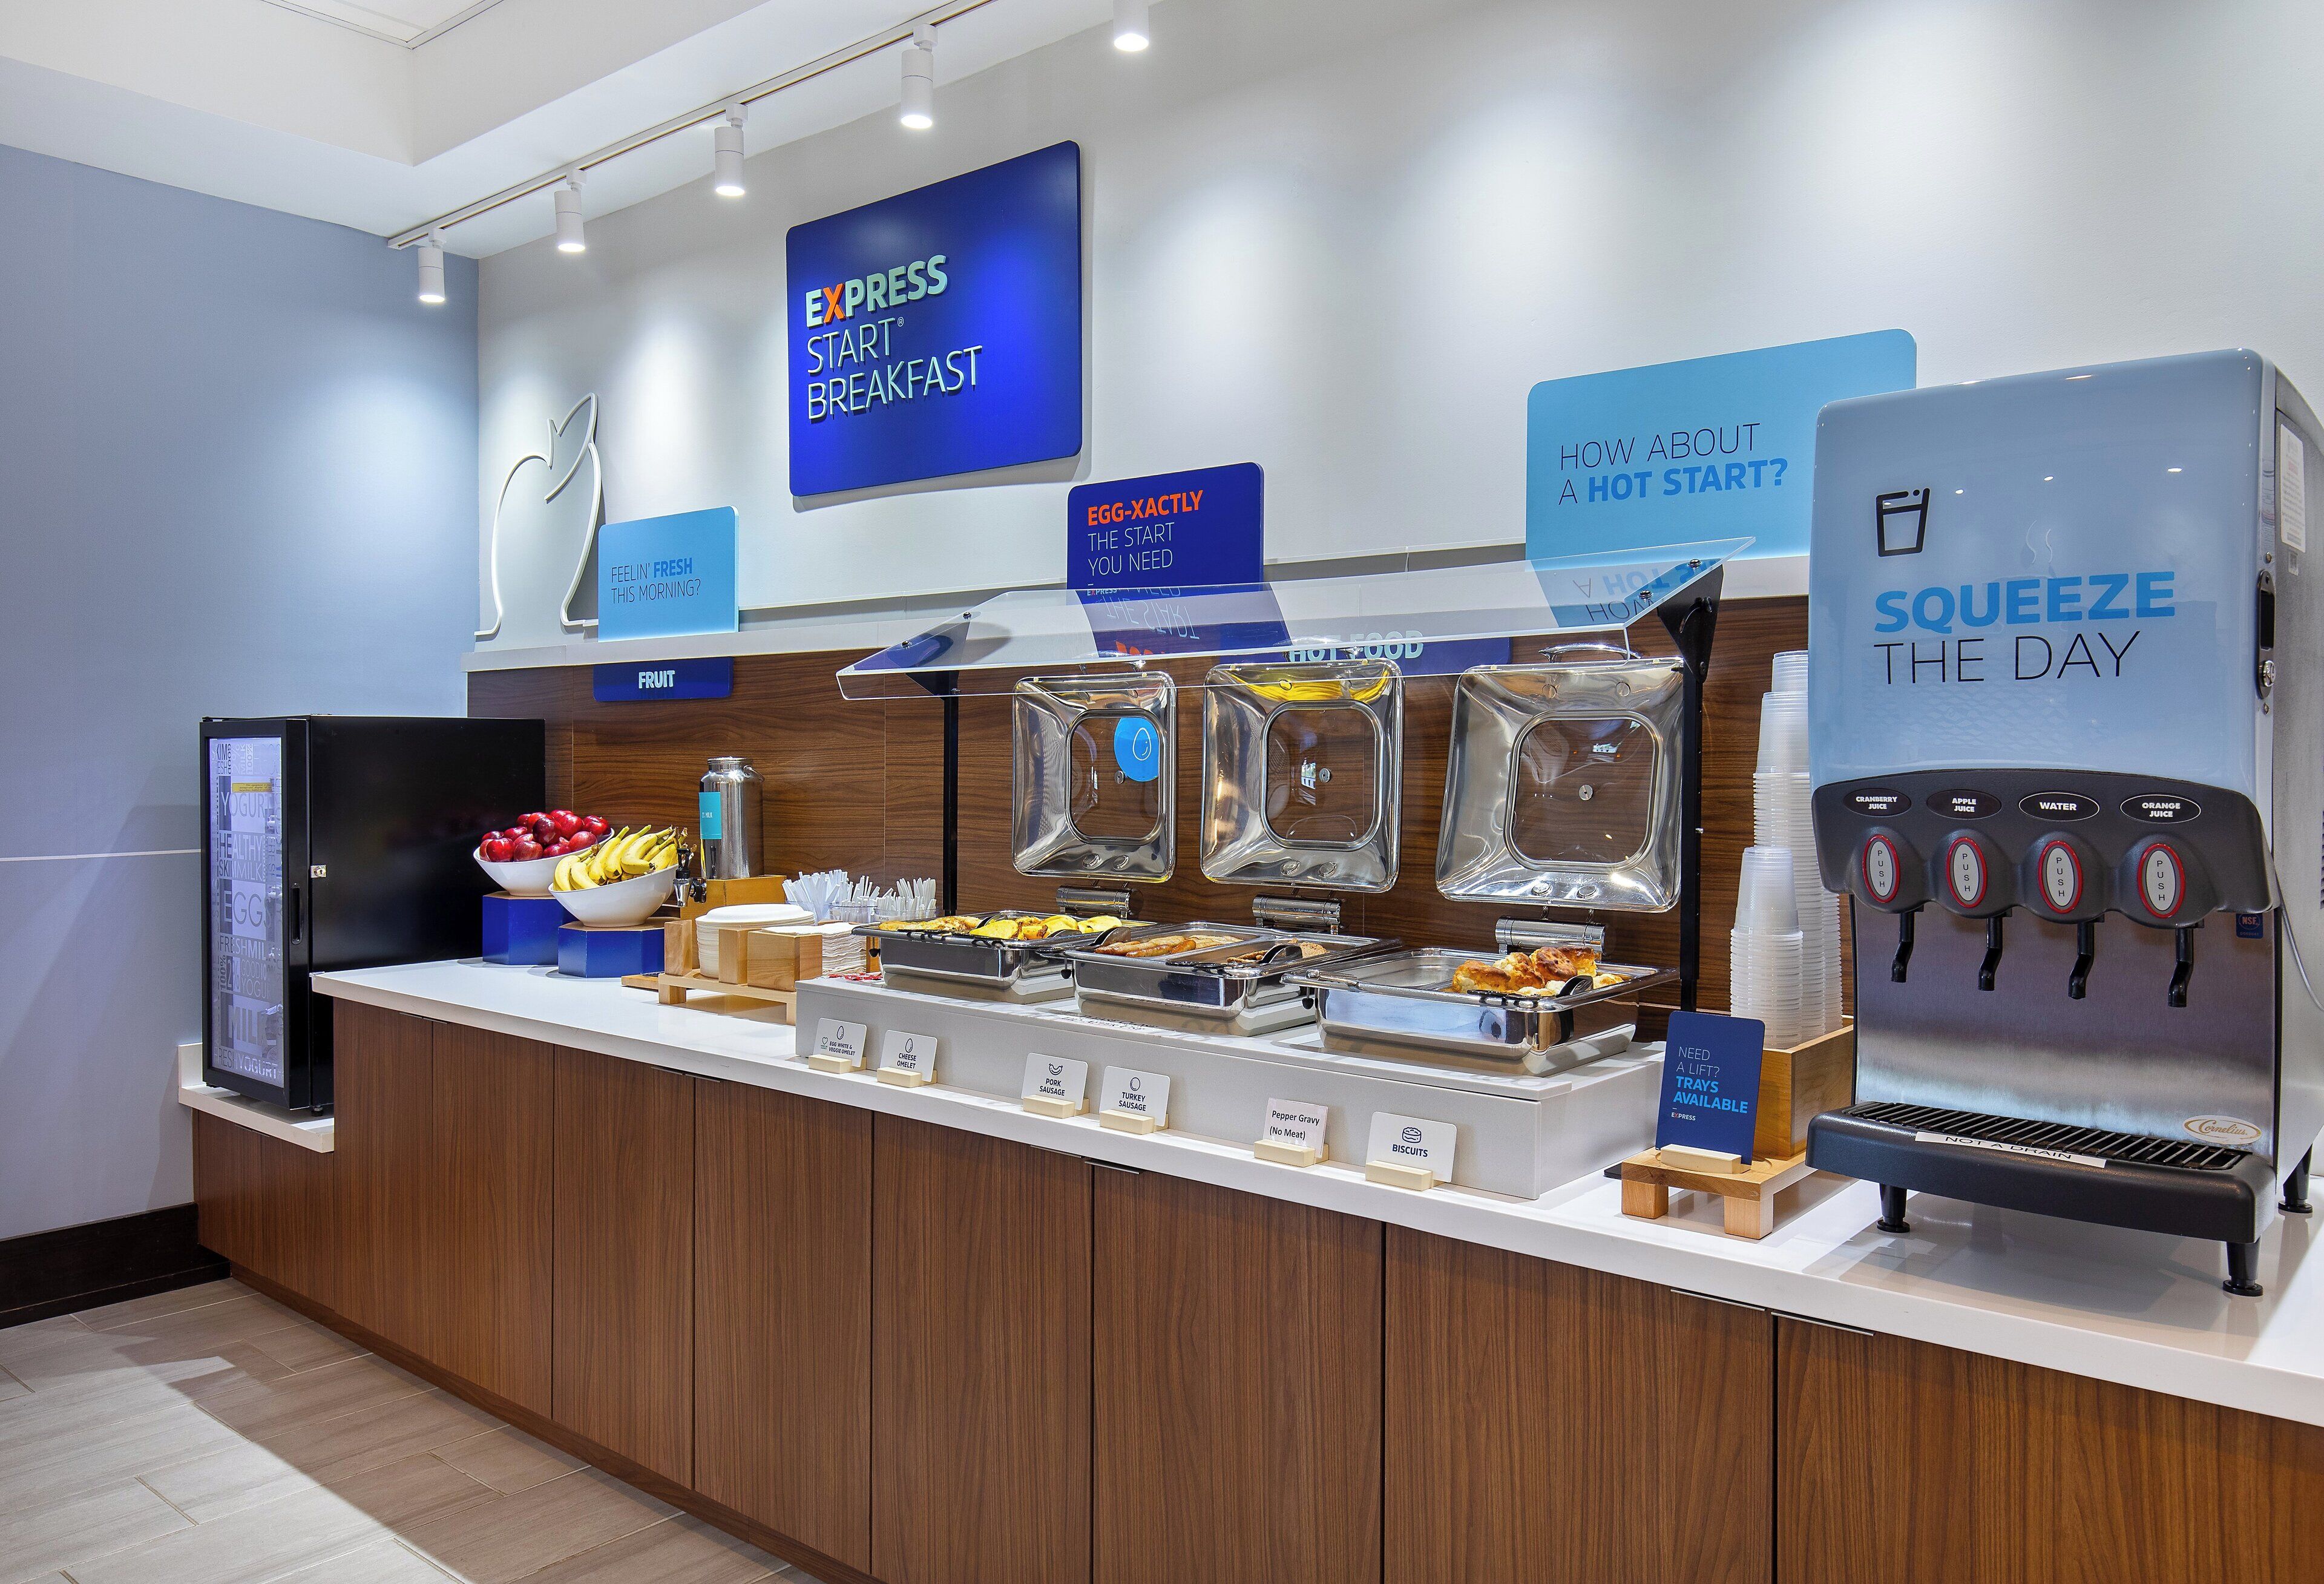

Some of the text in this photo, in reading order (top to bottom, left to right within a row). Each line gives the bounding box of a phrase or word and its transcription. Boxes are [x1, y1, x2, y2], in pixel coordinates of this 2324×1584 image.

[806, 255, 948, 327] EXPRESS
[807, 344, 983, 421] BREAKFAST
[1560, 422, 1761, 471] HOW ABOUT
[1558, 458, 1788, 505] A HOT START?
[1088, 490, 1204, 526] EGG-XACTLY
[1088, 522, 1175, 551] THE START
[654, 557, 693, 578] FRESH
[1088, 548, 1173, 576] YOU NEED
[611, 579, 701, 604] THIS MORNING?
[1874, 571, 2176, 634] SQUEEZE
[1350, 631, 1424, 660] FOOD
[1874, 631, 2141, 685] THE DAY
[638, 670, 675, 689] FRUIT
[221, 792, 272, 818] YOGURT
[2039, 801, 2077, 811] WATER
[220, 833, 263, 861] HEALTHY
[2056, 857, 2065, 897] PUSH
[2157, 860, 2165, 901] PUSH
[897, 1060, 916, 1069] OMELET
[899, 1053, 916, 1062] CHEESE
[1679, 1047, 1710, 1061] NEED
[1676, 1061, 1720, 1077] A LIFT?
[1040, 1085, 1065, 1096] SAUSAGE
[1045, 1078, 1062, 1087] PORK
[1676, 1076, 1719, 1093] TRAYS
[1118, 1100, 1146, 1111] SAUSAGE
[1121, 1091, 1146, 1102] TURKEY
[1673, 1091, 1748, 1114] AVAILABLE
[1272, 1110, 1320, 1126] Pepper Gravy
[1672, 1112, 1696, 1121] EXPRESS
[1269, 1126, 1306, 1141] (No Meat)
[1392, 1144, 1428, 1157] BISCUITS
[1945, 1137, 1986, 1145] NOT
[2011, 1146, 2072, 1159] DRAIN
